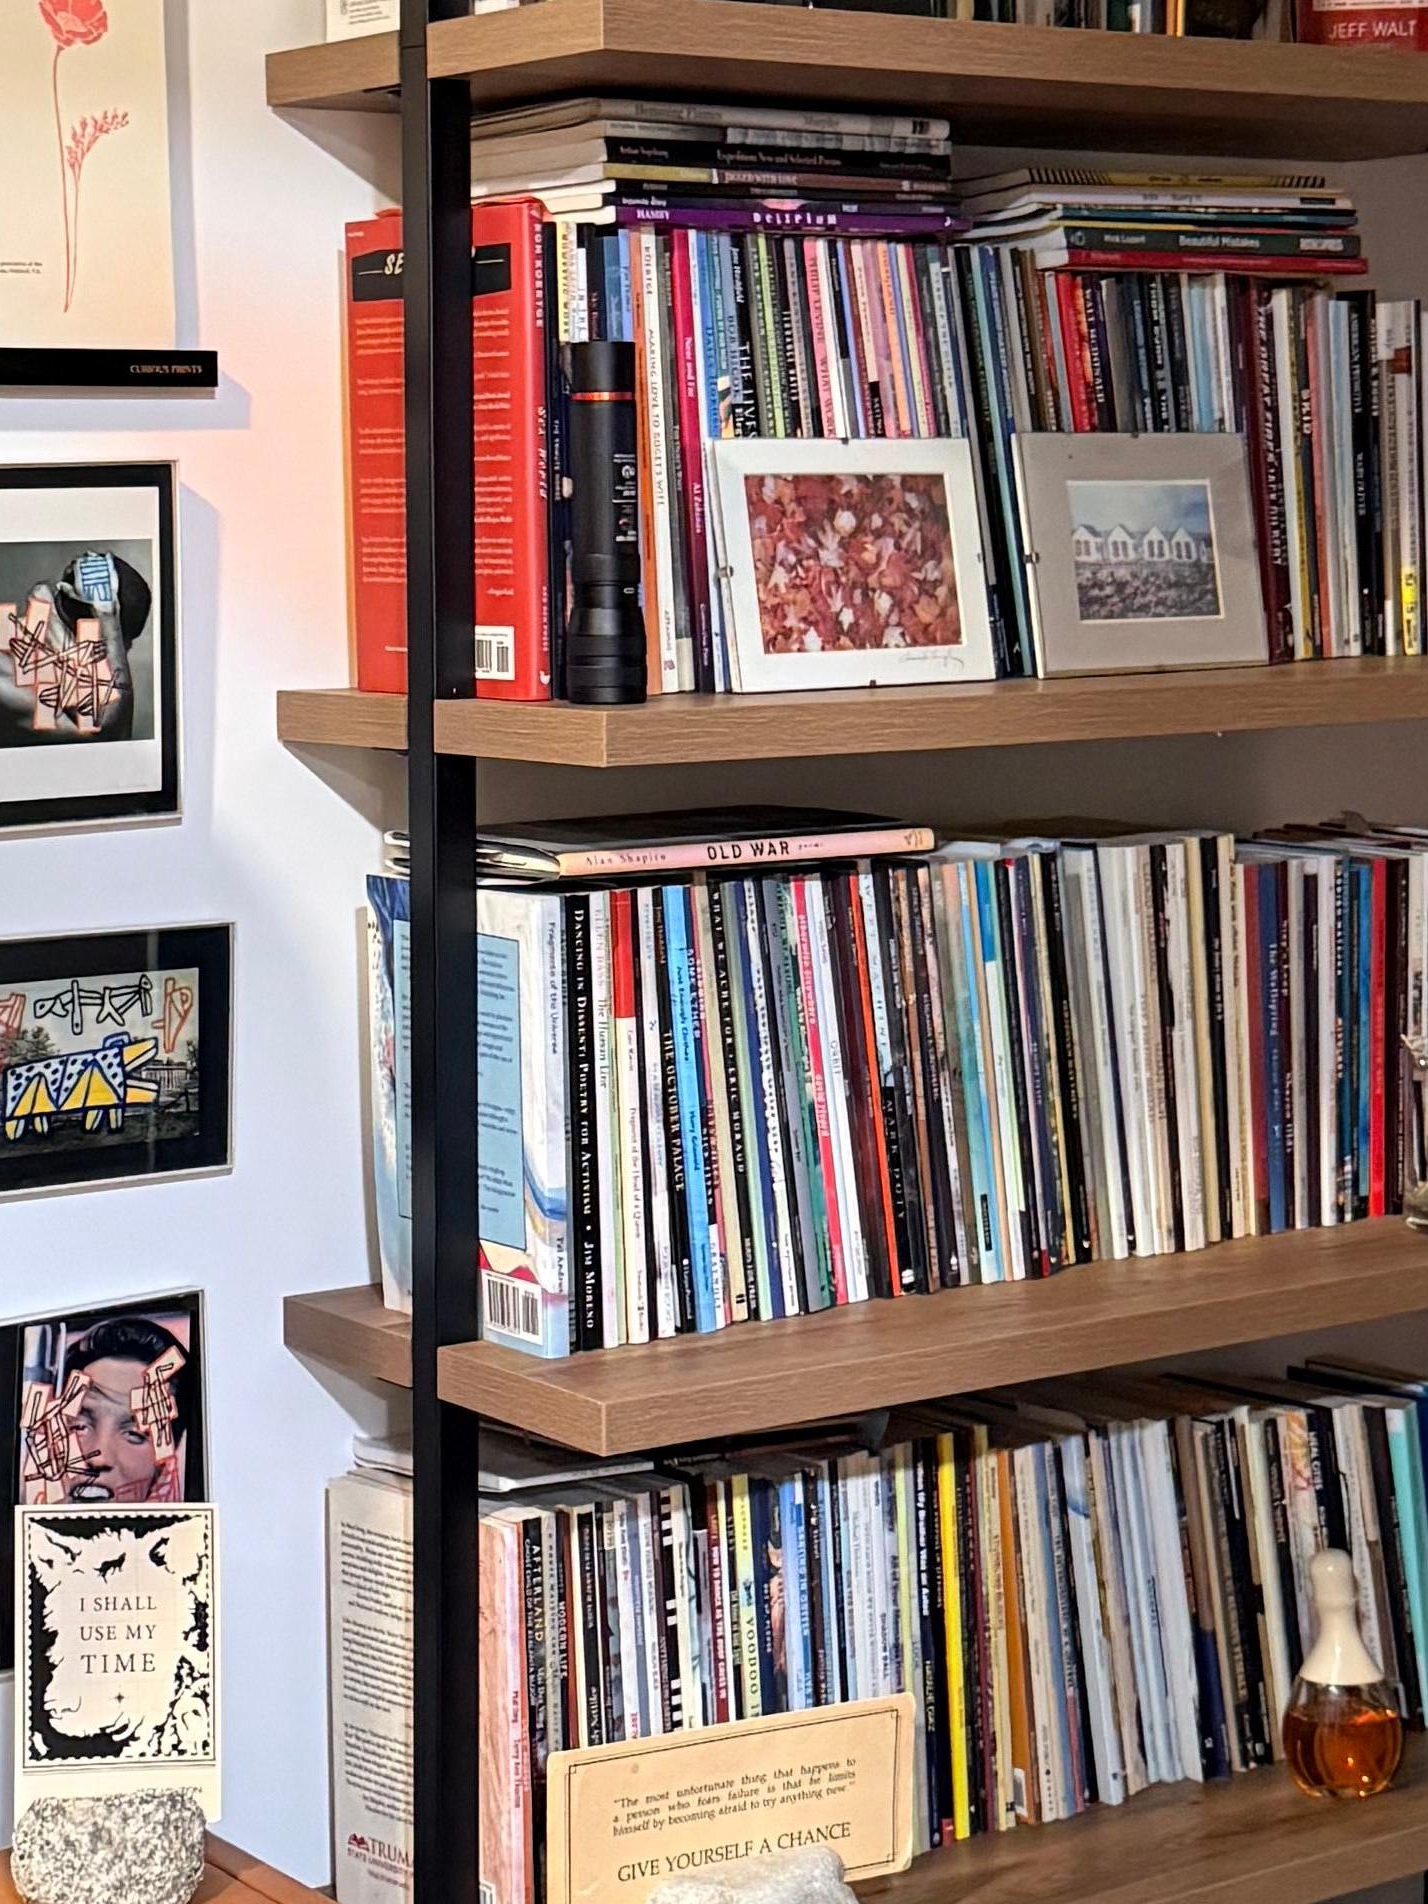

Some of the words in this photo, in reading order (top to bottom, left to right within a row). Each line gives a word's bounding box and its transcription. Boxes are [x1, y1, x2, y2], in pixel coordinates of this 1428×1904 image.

[1329, 22, 1368, 40] JEFF
[1373, 20, 1417, 37] WALT
[585, 854, 614, 866] Alan
[619, 851, 667, 865] Shapiro
[707, 843, 742, 861] OLD
[751, 840, 790, 857] WAR
[574, 910, 585, 970] DANCING
[577, 976, 586, 989] IN
[662, 1031, 674, 1061] THE
[578, 1063, 589, 1114] POETRY
[666, 1065, 680, 1132] OCTOBER
[580, 1121, 590, 1144] FOR
[581, 1151, 592, 1214] ACTIVISM
[670, 1135, 684, 1192] PALACE
[584, 1241, 595, 1265] JIM
[585, 1271, 596, 1328] MORENO
[80, 1597, 84, 1612] I
[93, 1596, 158, 1612] SHALL
[532, 1543, 544, 1642] AFTERLAND
[80, 1626, 117, 1641] USE
[126, 1624, 156, 1640] MY
[80, 1653, 156, 1674] TIME
[746, 1616, 759, 1695] VOODOO
[924, 1659, 933, 1704] NATALIE
[925, 1707, 935, 1732] DIAZ
[612, 1815, 619, 1823] a
[626, 1807, 661, 1822] person
[668, 1800, 690, 1812] who
[697, 1796, 720, 1807] fears
[728, 1787, 760, 1801] failure
[767, 1785, 776, 1793] is
[783, 1781, 802, 1791] that
[809, 1777, 821, 1786] he
[828, 1771, 856, 1782] limits
[645, 1792, 669, 1802] most
[676, 1778, 735, 1797] unfortunate
[741, 1773, 767, 1787] thing
[774, 1767, 793, 1778] that
[800, 1761, 840, 1776] happens
[846, 1758, 856, 1767] to
[612, 1819, 650, 1836] himself
[653, 1817, 665, 1831] by
[668, 1808, 716, 1825] becoming
[719, 1802, 747, 1815] afraid
[750, 1800, 760, 1809] to
[763, 1797, 776, 1809] try
[779, 1788, 823, 1805] anything
[617, 1859, 660, 1882] GIVE
[666, 1840, 754, 1873] YOURSELF
[759, 1838, 772, 1854] A
[777, 1821, 852, 1850] CHANCE
